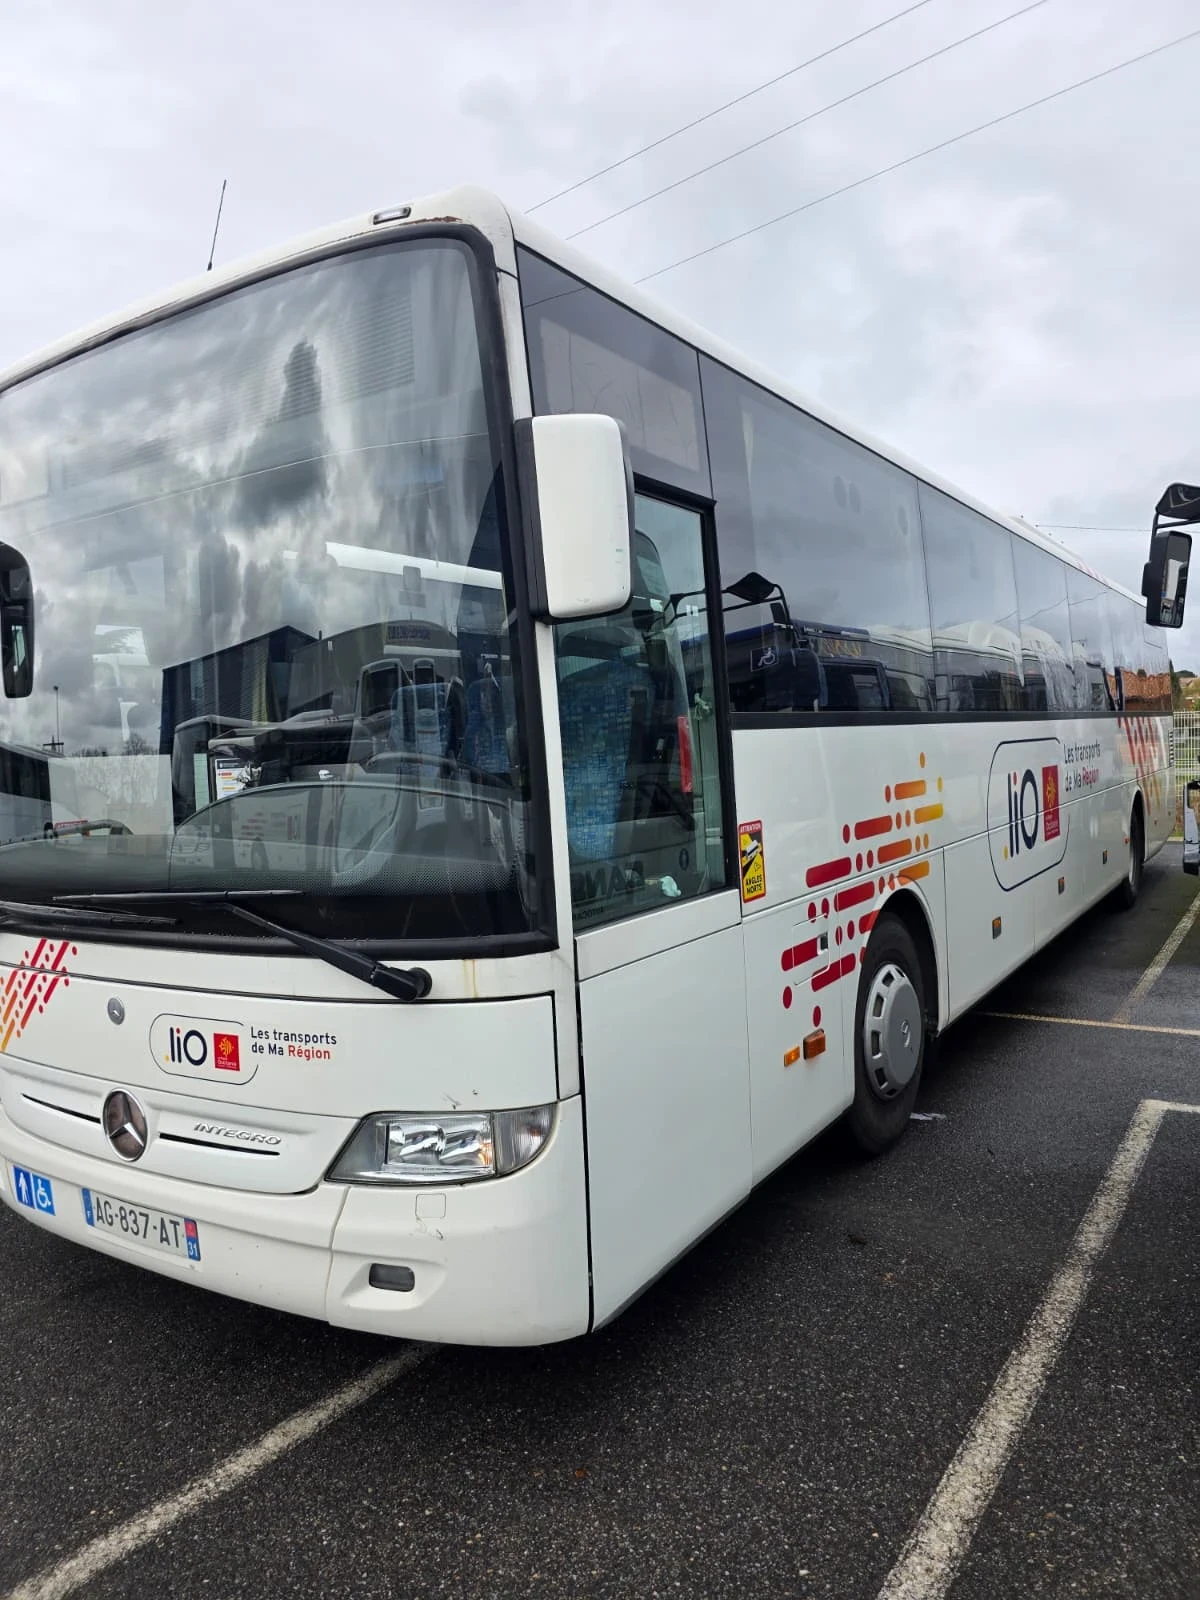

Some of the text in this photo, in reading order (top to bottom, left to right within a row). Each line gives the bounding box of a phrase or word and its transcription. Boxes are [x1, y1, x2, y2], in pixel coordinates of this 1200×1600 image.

[1063, 740, 1101, 764] Les transports
[1065, 771, 1072, 792] de
[1073, 769, 1082, 789] Ma
[745, 874, 763, 886] ANGLES
[746, 883, 762, 894] MORTS
[250, 1026, 337, 1047] Les transports
[251, 1042, 331, 1061] de Ma Région
[193, 1122, 282, 1145] INTEGRO
[96, 1197, 180, 1249] AG-837-AT
[188, 1241, 198, 1257] 31
